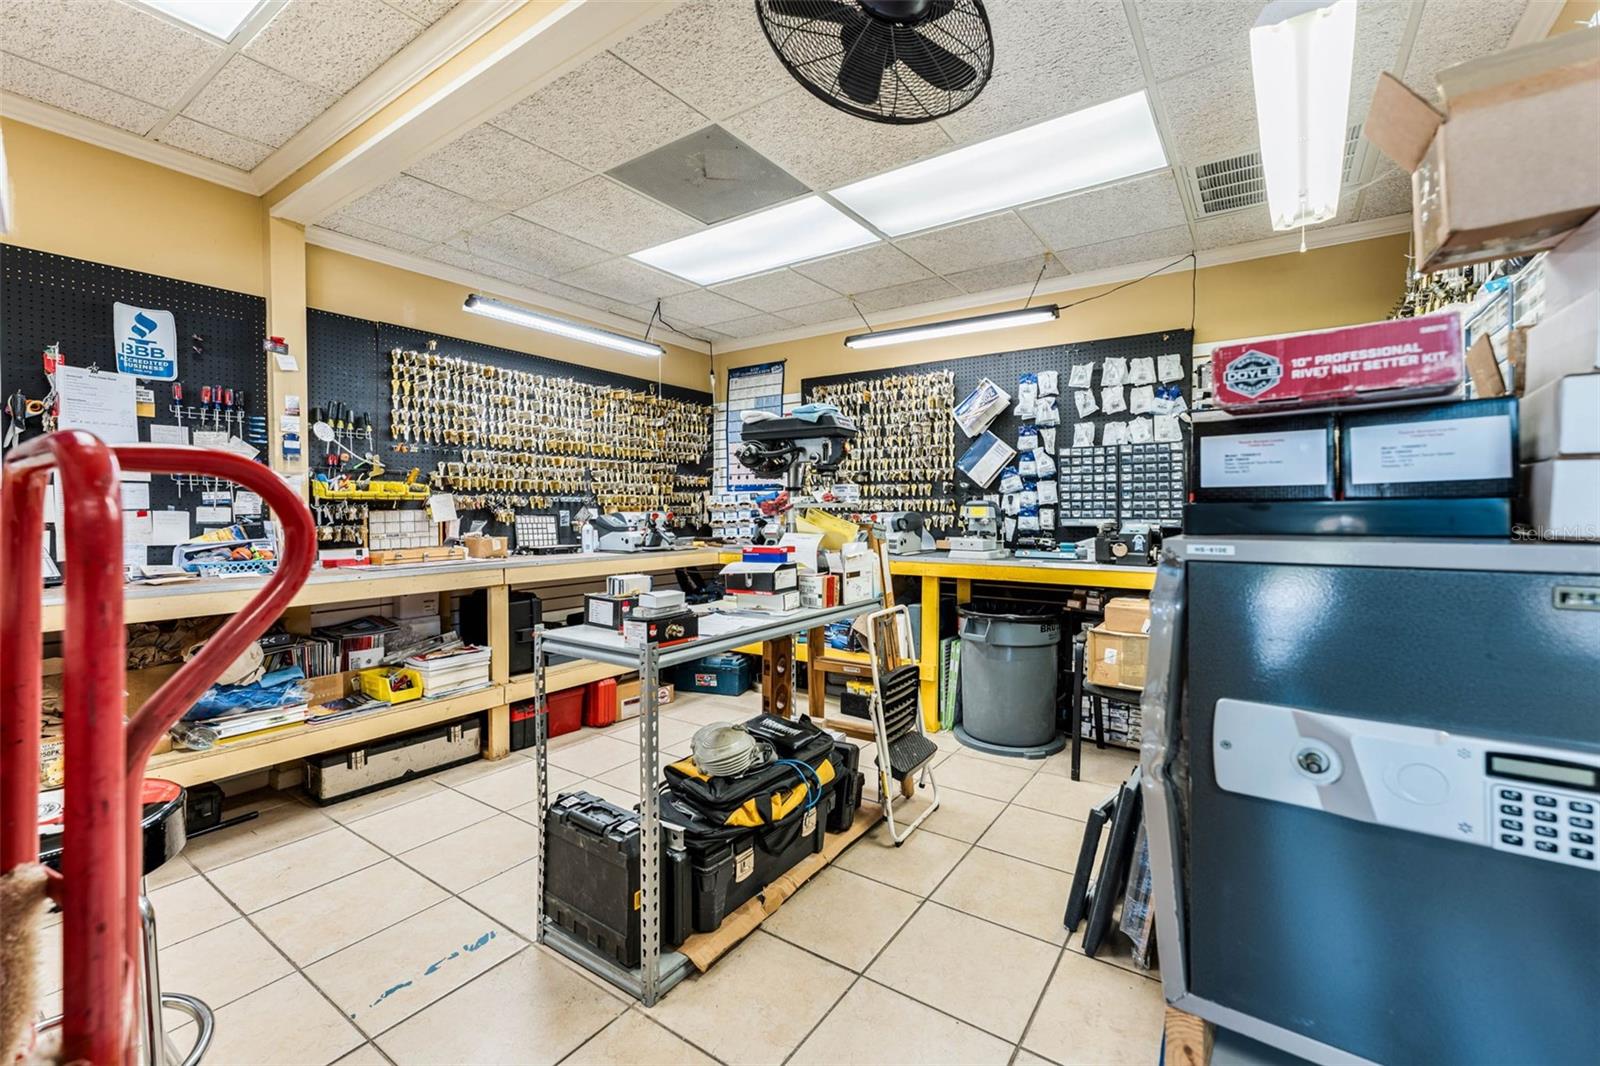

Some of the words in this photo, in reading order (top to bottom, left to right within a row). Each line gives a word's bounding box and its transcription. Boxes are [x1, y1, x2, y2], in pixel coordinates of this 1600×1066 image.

[121, 342, 165, 359] BBB
[1291, 356, 1312, 368] 10"
[1315, 342, 1423, 365] PROFESSIONAL
[120, 354, 169, 367] ACCREDITED
[124, 361, 164, 371] BUSINESS
[1291, 366, 1329, 380] RIVET
[1332, 362, 1360, 375] NUT
[1362, 354, 1419, 371] SETTER
[1422, 351, 1448, 363] KIT
[1228, 366, 1277, 381] DOYLE
